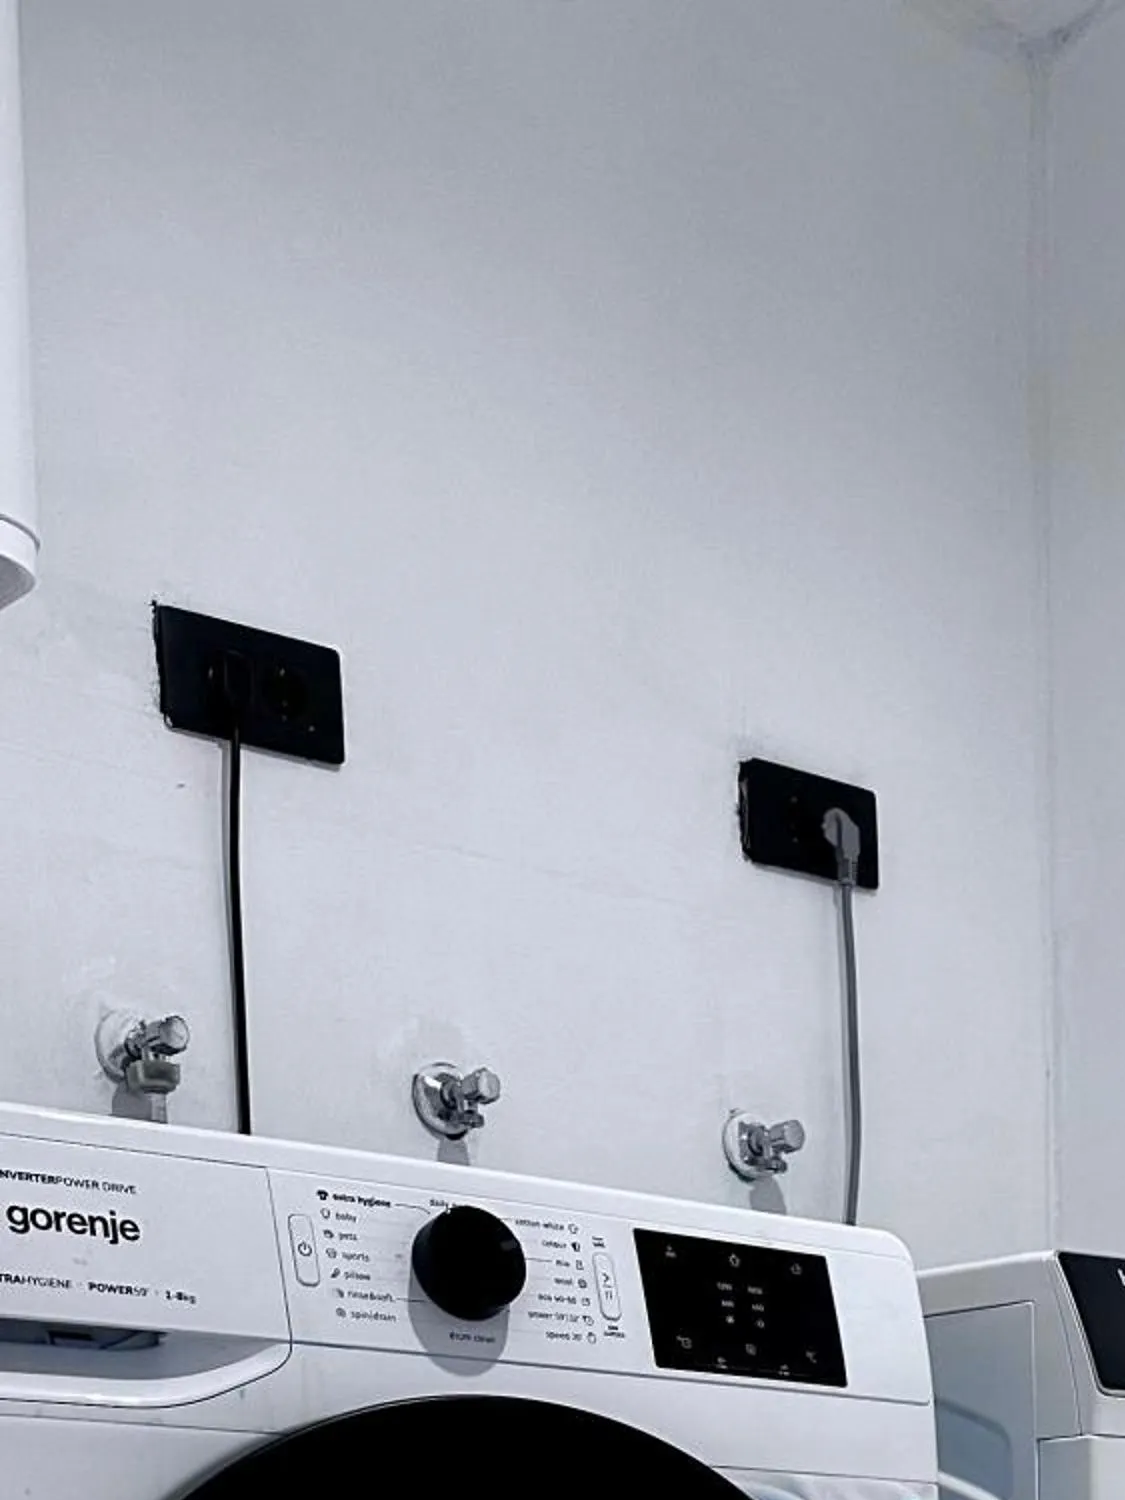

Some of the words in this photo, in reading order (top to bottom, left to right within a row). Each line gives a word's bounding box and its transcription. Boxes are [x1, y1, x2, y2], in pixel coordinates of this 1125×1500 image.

[0, 1170, 100, 1190] NVERTERPOWER
[102, 1181, 137, 1194] DRIVE
[358, 1195, 391, 1208] hygiene
[6, 1205, 141, 1245] gorenje
[0, 1273, 72, 1289] TRAHYGIENE
